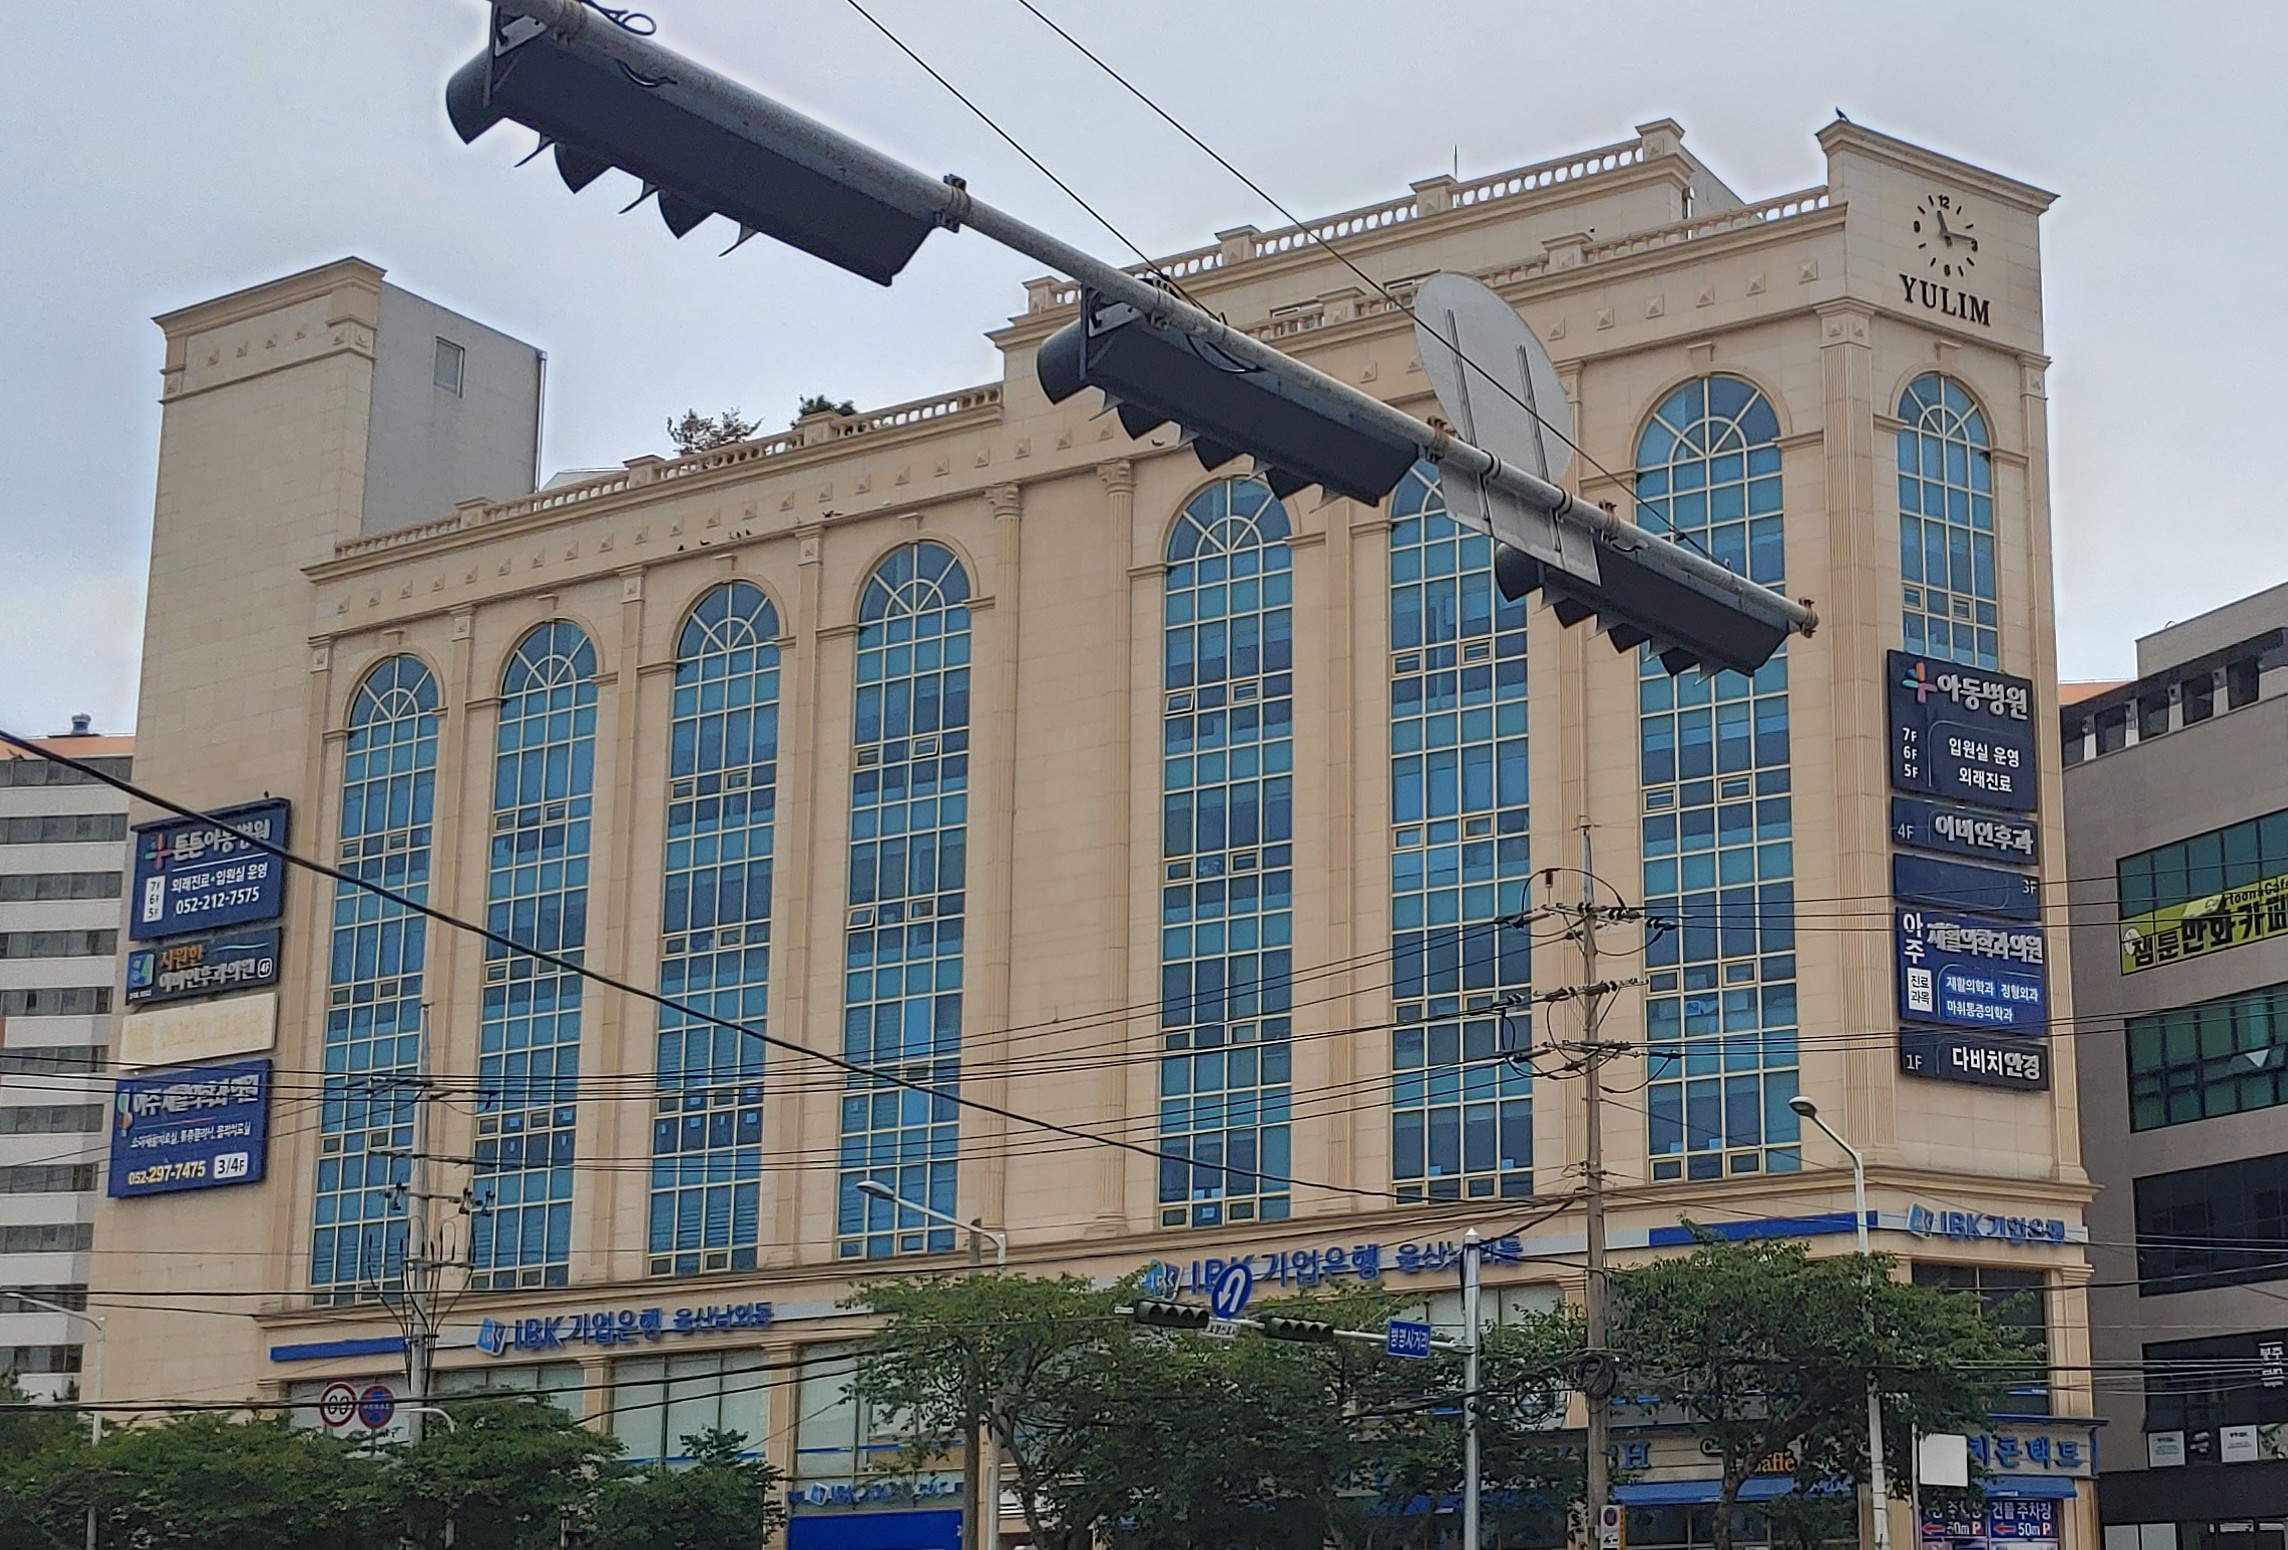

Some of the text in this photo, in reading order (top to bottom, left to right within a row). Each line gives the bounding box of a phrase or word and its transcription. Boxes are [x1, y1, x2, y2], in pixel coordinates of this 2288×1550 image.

[1938, 195, 1950, 209] 12
[1971, 239, 1978, 252] 3
[1899, 273, 1990, 327] YULIM
[1937, 674, 2028, 720] 아동병원
[1902, 728, 1918, 743] 7F
[1903, 746, 1918, 761] 6F
[1949, 737, 2020, 767] 입원실 운영
[1904, 764, 1919, 779] 5F
[1959, 767, 2013, 793] 외래진료
[1898, 823, 1914, 840] 4F
[1935, 815, 2034, 855] 이비인후과
[247, 862, 268, 880] 운영
[175, 886, 260, 915] 052-212-7575
[159, 958, 256, 993] 이비인후과의원
[1910, 975, 1930, 989] 진료
[1946, 976, 2039, 1003] 재활의학과 정형외과
[1946, 1000, 2013, 1022] 마취통증의학과
[1906, 1054, 1923, 1070] 1F
[1952, 1046, 2040, 1081] 다비치안경
[217, 1158, 245, 1175] 3/4F
[514, 1302, 775, 1351] IBK기업은행 울산남외동
[1992, 1501, 2014, 1520] 건물
[2017, 1502, 2052, 1520] 주차장
[2018, 1522, 2040, 1536] 50m
